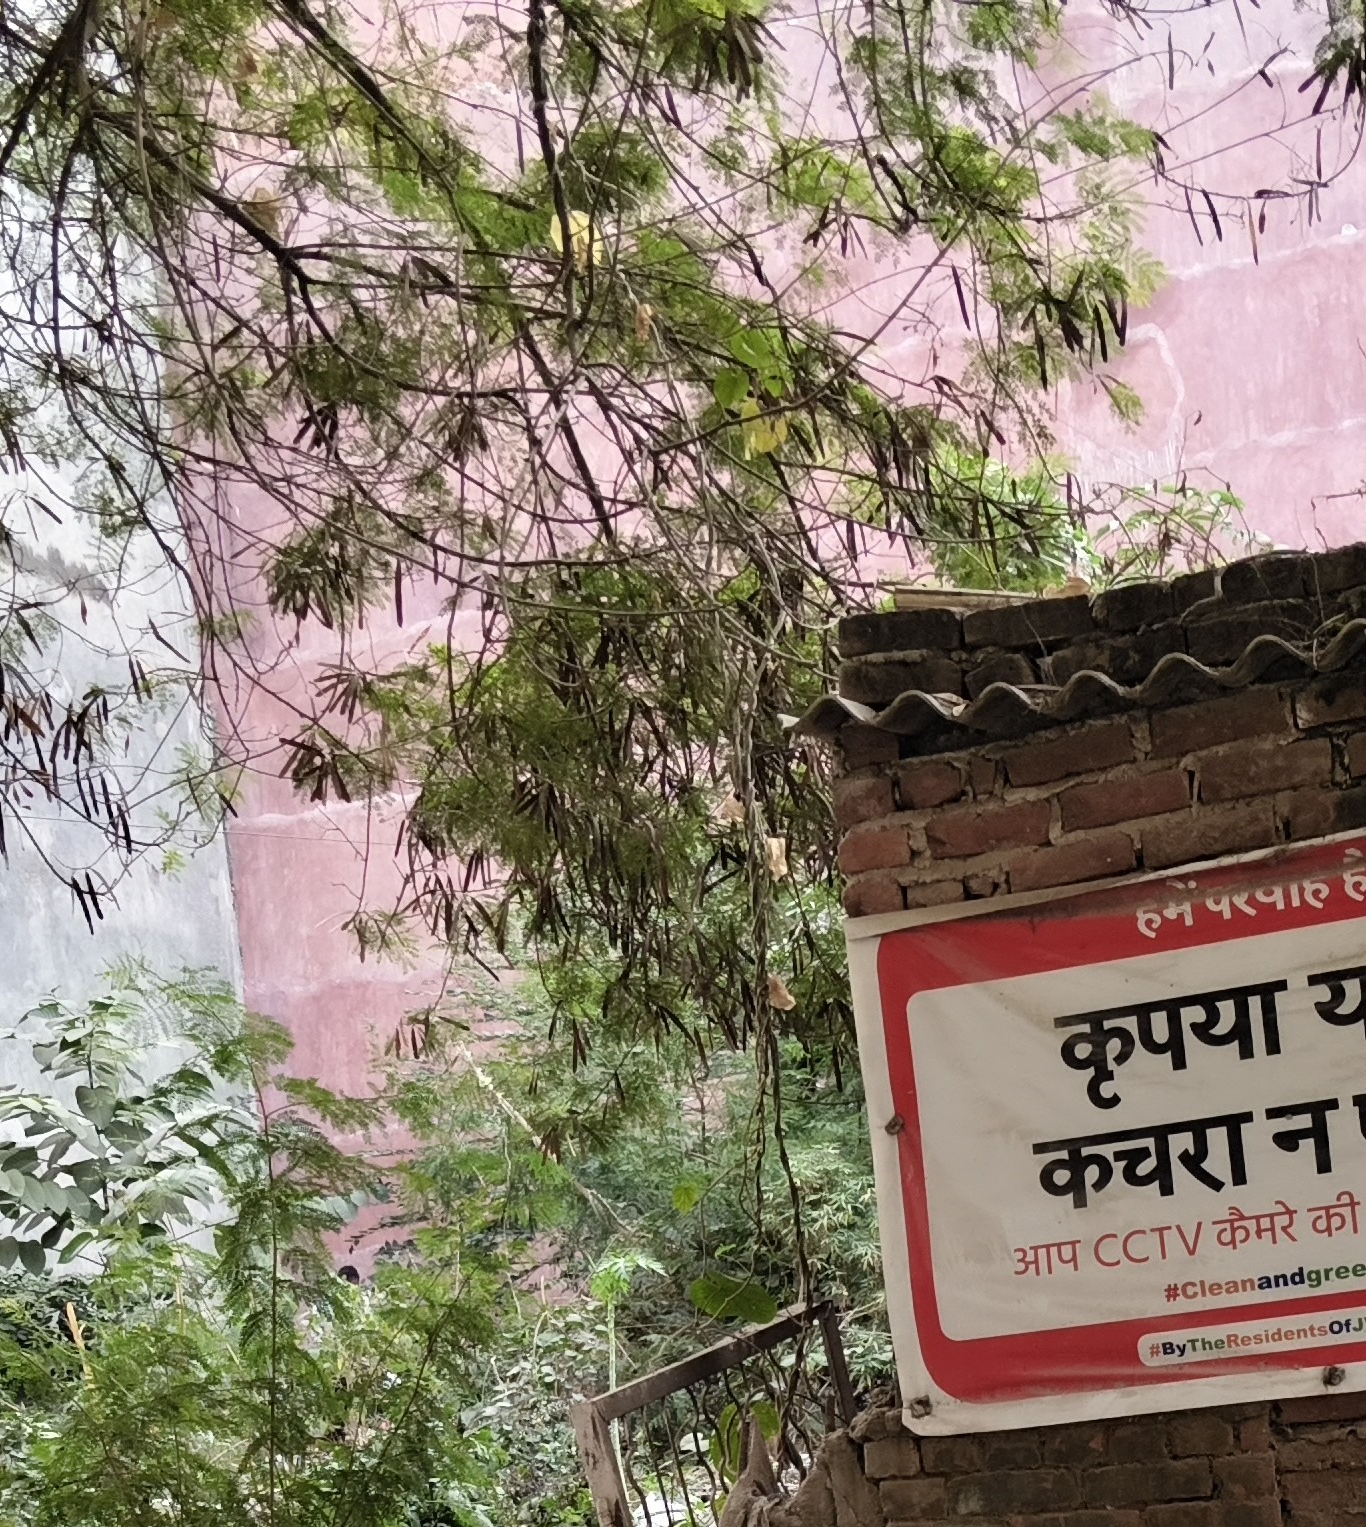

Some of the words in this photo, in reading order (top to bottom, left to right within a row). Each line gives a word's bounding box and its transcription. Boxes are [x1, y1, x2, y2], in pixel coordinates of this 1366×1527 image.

[1053, 978, 1288, 1110] कृपया
[1032, 1111, 1254, 1210] कचरा
[1265, 1097, 1340, 1175] न
[1013, 1239, 1082, 1277] आप
[1093, 1221, 1203, 1268] CCTV
[1211, 1199, 1298, 1251] कैमरे
[1306, 1190, 1361, 1238] की
